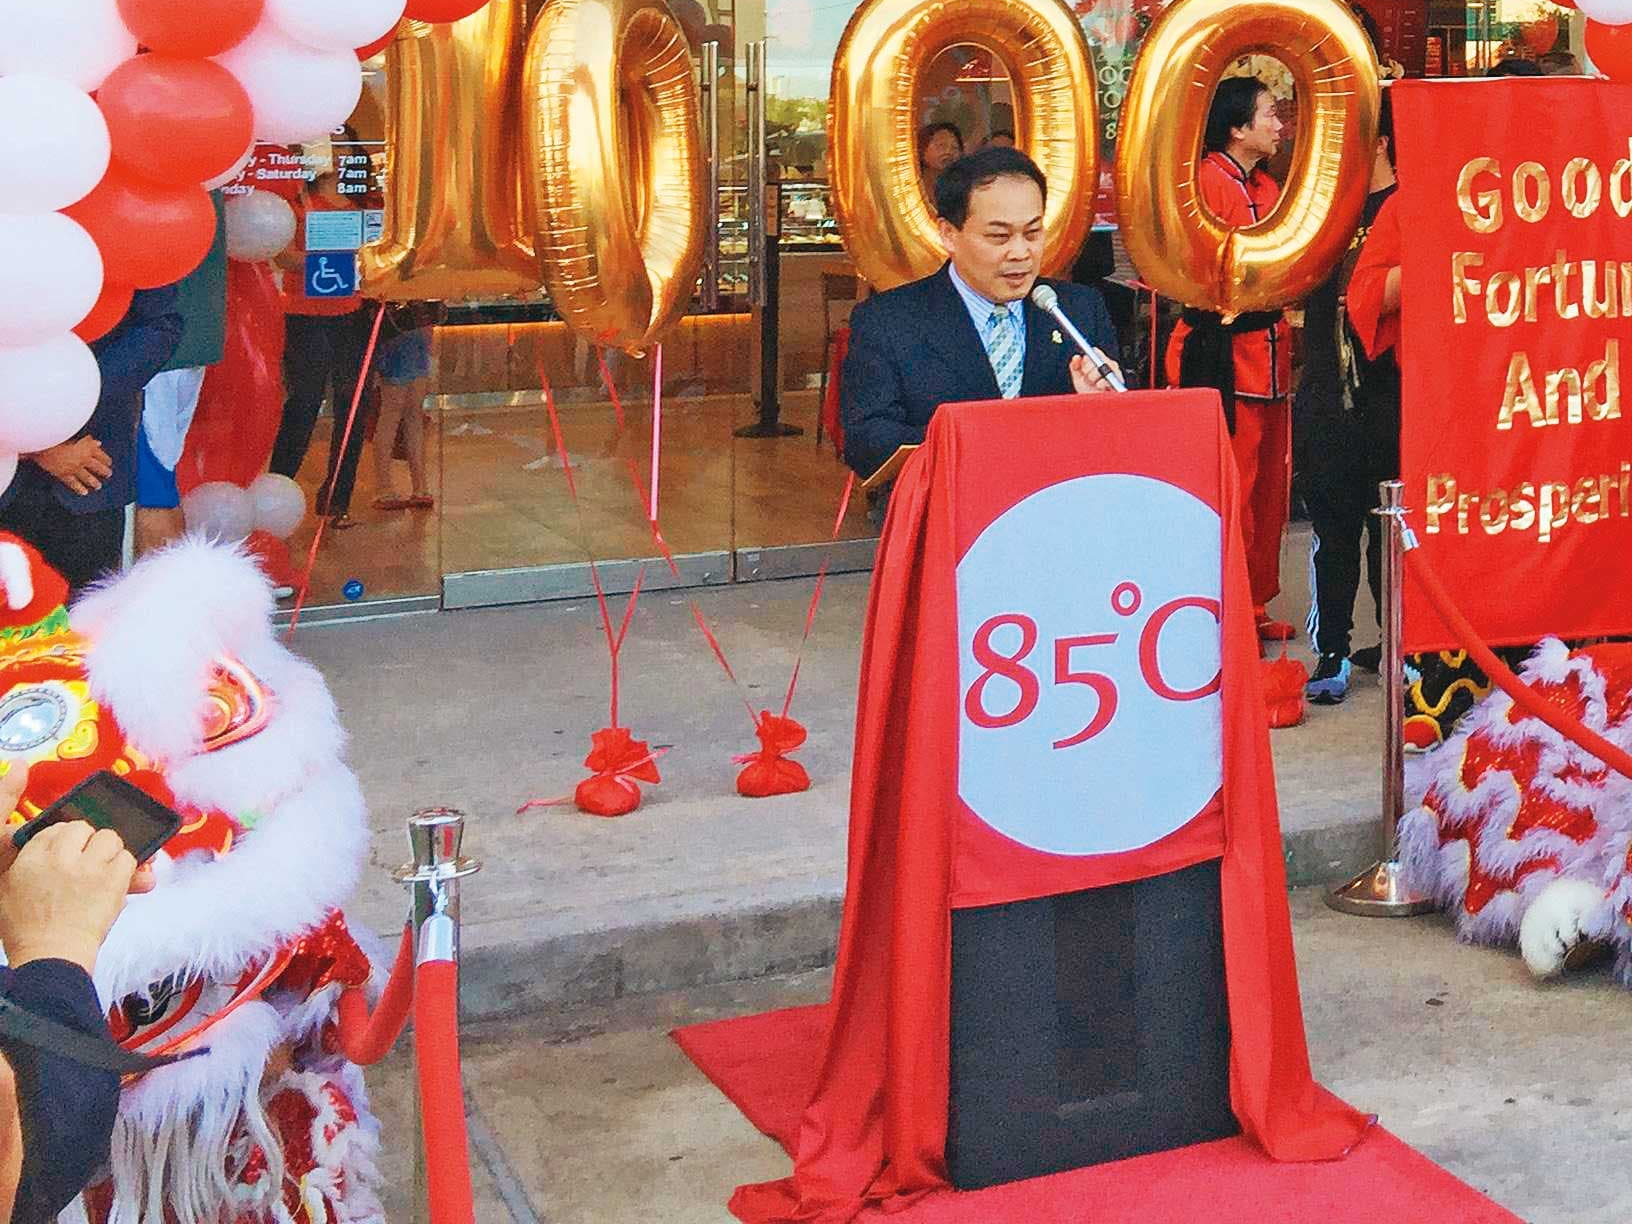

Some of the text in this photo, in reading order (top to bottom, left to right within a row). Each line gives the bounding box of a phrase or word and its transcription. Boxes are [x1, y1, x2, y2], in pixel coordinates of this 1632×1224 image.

[256, 167, 317, 182] Saturday
[338, 167, 367, 179] 7am
[1496, 338, 1621, 430] And
[964, 581, 1222, 750] 85°C
